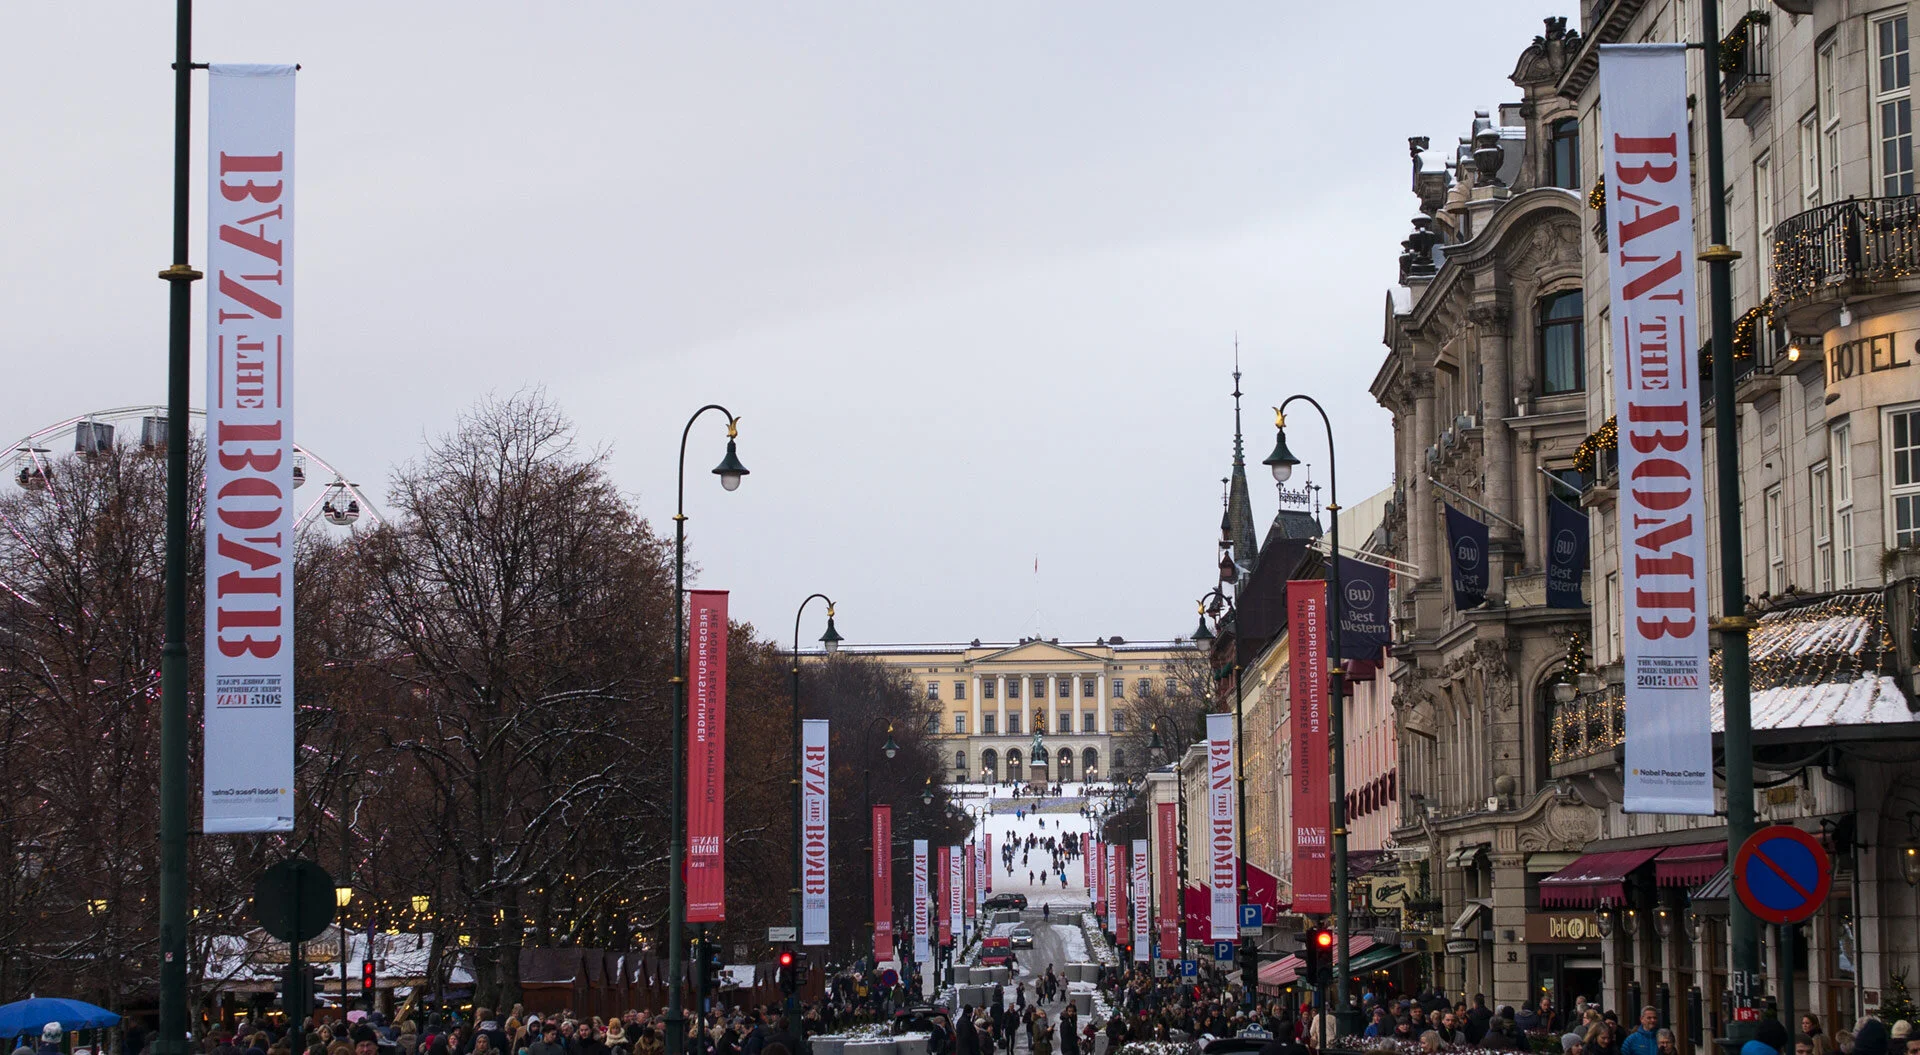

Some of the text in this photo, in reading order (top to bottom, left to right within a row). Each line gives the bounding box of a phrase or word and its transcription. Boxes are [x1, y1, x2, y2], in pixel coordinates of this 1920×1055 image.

[1831, 332, 1911, 383] HOTEL
[1614, 132, 1696, 640] BAN THE BOMB
[1458, 546, 1477, 561] BW
[1551, 564, 1572, 579] Best
[1349, 588, 1371, 601] BW
[1348, 610, 1375, 622] Best
[1340, 619, 1386, 633] Western
[1307, 598, 1319, 733] FREDSPRISUTSTILLINGEN
[1637, 675, 1698, 686] 2017: ICAN
[1210, 739, 1232, 791] BAN
[1640, 768, 1705, 777] Nobel Peace Center
[1218, 793, 1227, 816] THE
[1297, 827, 1316, 836] BAN
[1297, 835, 1326, 844] BOMB
[1213, 818, 1233, 889] BOMB
[1135, 853, 1146, 881] BAN
[1136, 896, 1147, 935] BOMB
[1244, 908, 1256, 925] P
[1549, 917, 1567, 938] Deli
[1585, 917, 1604, 938] Luc
[1219, 944, 1229, 958] P
[1507, 951, 1518, 961] 33
[1185, 963, 1194, 974] P
